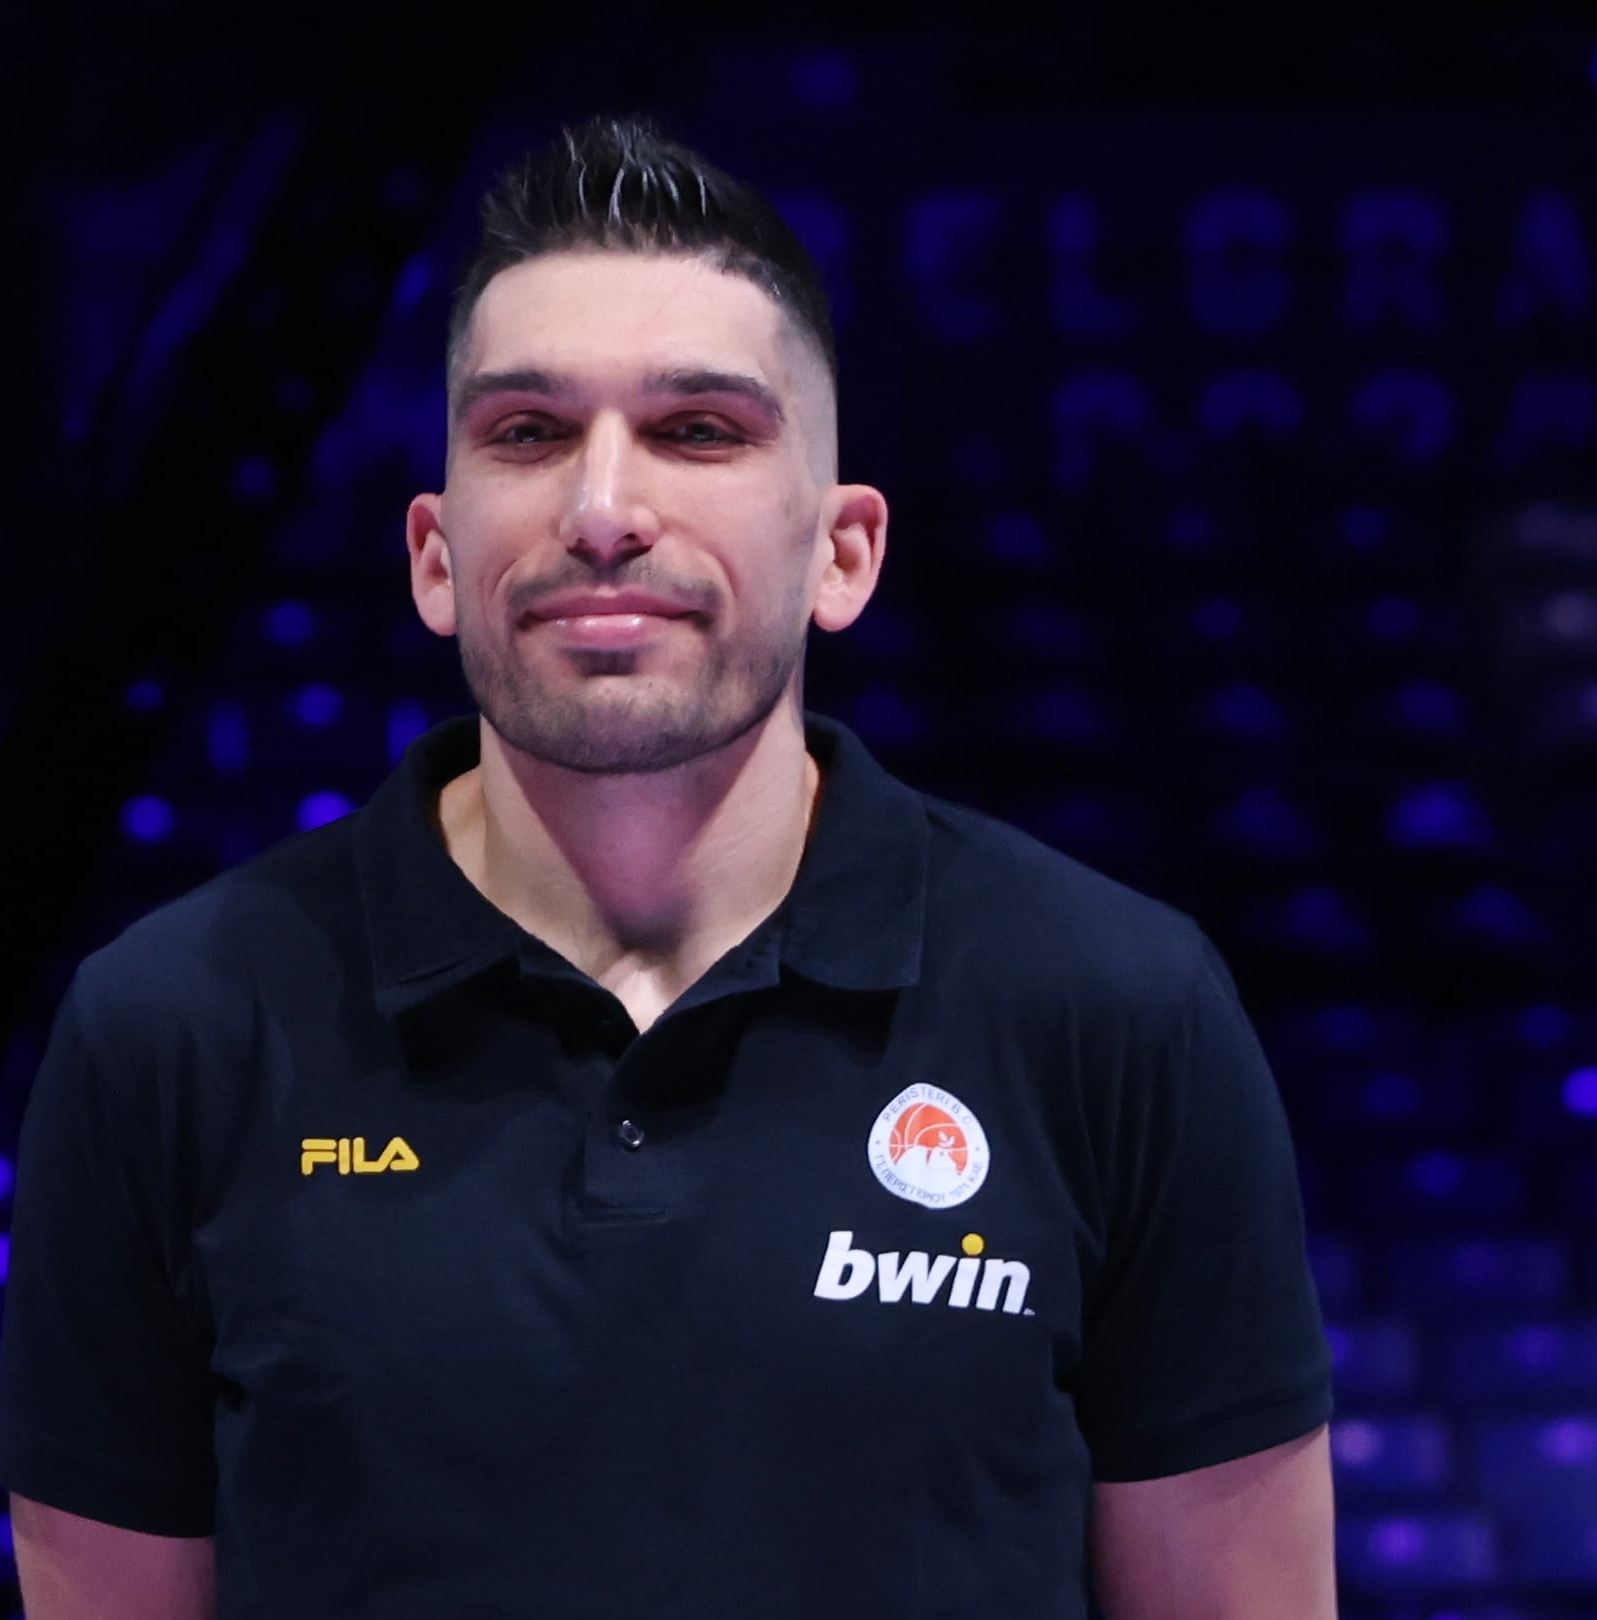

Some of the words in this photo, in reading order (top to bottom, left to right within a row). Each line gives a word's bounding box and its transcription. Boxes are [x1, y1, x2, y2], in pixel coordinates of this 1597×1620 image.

[882, 1086, 950, 1122] PERISTERI
[301, 1136, 419, 1175] FILA
[813, 1230, 1031, 1315] bwin
